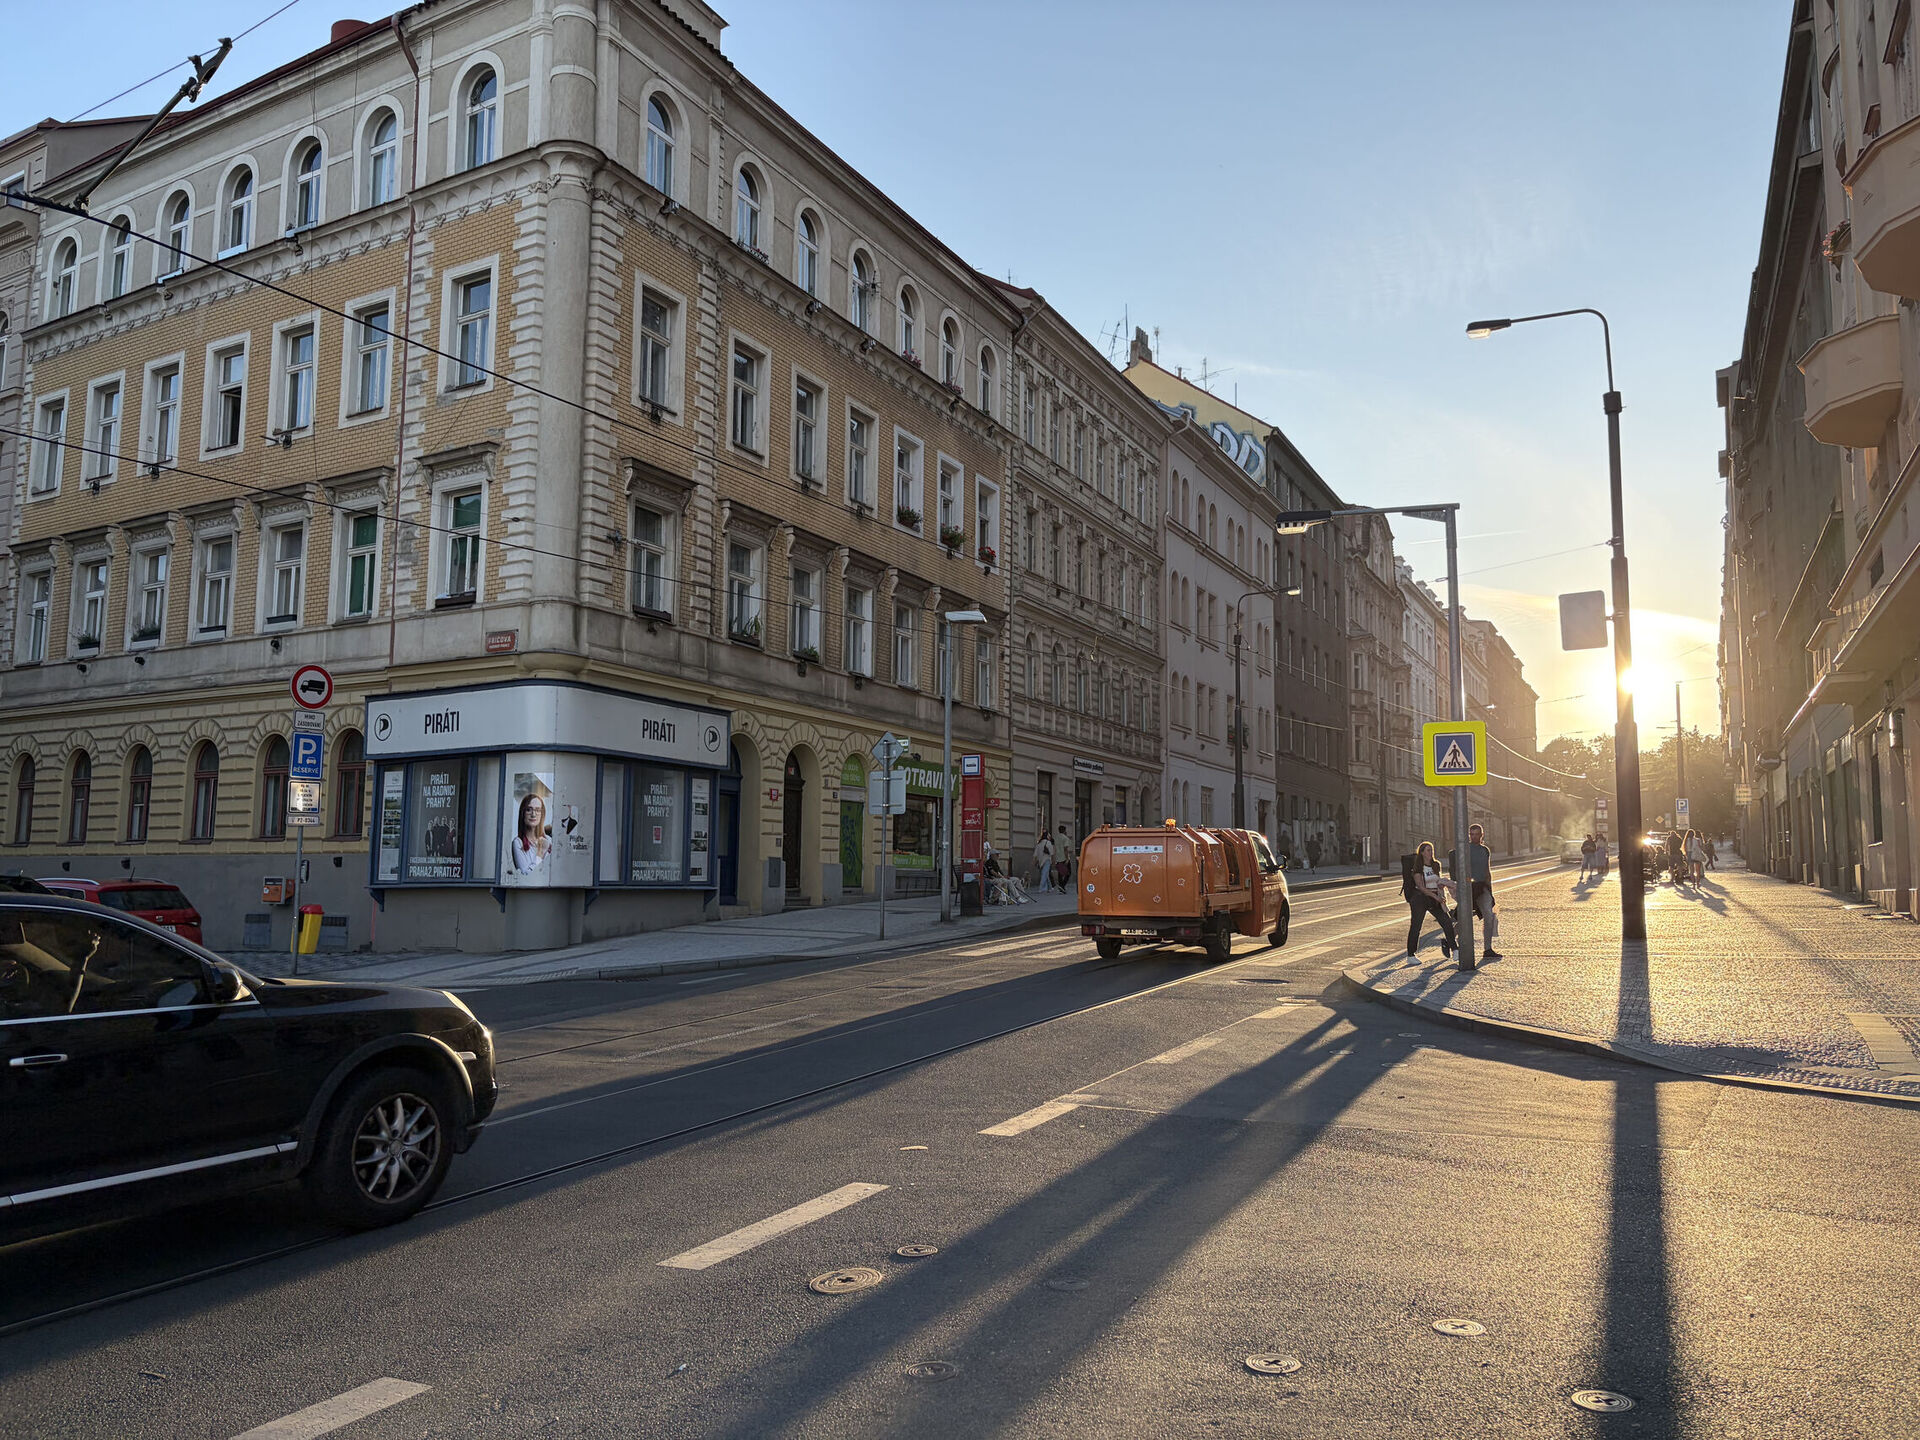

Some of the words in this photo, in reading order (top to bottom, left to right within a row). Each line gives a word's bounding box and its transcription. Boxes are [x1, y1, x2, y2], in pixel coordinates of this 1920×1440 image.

[424, 708, 460, 735] PIRÁTI
[641, 717, 676, 744] PIRÁTI
[297, 737, 317, 765] P
[430, 771, 449, 785] PIRÁTI
[898, 765, 957, 792] OTRAVIY
[423, 785, 432, 797] NA
[432, 784, 456, 796] RADNICI
[650, 782, 668, 794] PIRÁTI
[426, 797, 446, 808] PRAHY
[446, 796, 452, 808] 2
[643, 795, 652, 805] NA
[1678, 800, 1686, 810] P
[647, 806, 665, 817] PRAHY
[665, 806, 670, 817] 2
